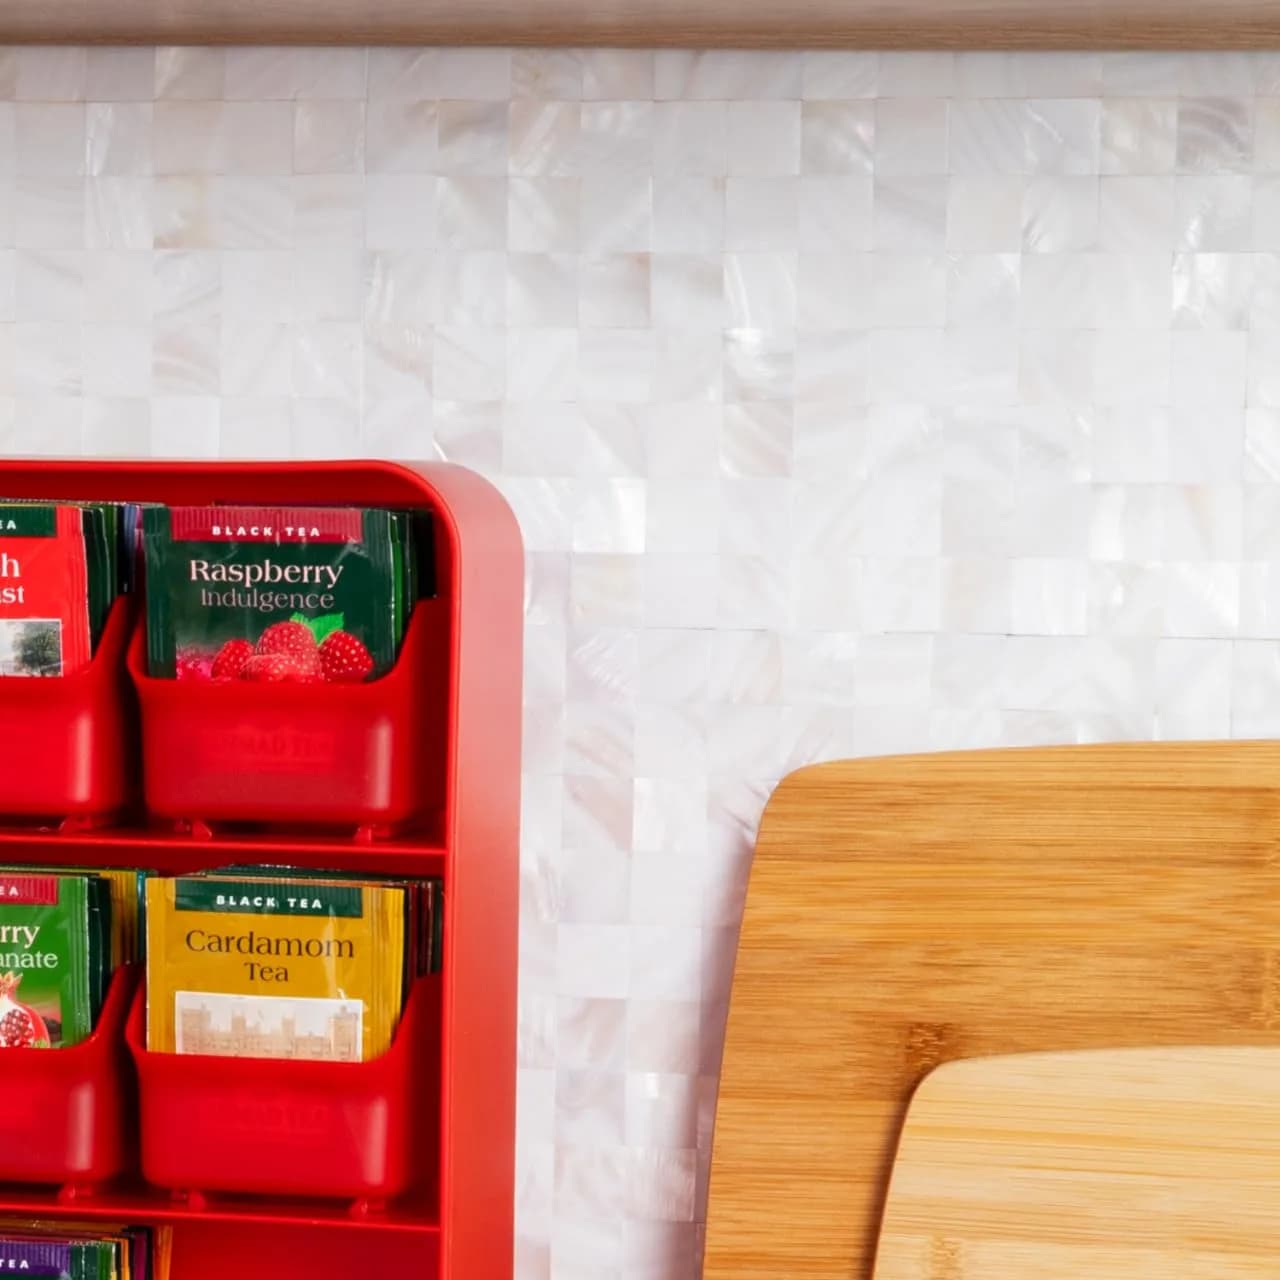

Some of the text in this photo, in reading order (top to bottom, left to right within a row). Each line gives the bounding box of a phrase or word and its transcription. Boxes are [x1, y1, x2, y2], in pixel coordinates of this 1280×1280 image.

[212, 526, 320, 537] BLACK TEA
[189, 559, 344, 588] Raspberry
[201, 588, 334, 612] Indulgence
[216, 895, 322, 909] BLACK TEA
[185, 930, 354, 959] Cardamom
[244, 962, 289, 982] Tea
